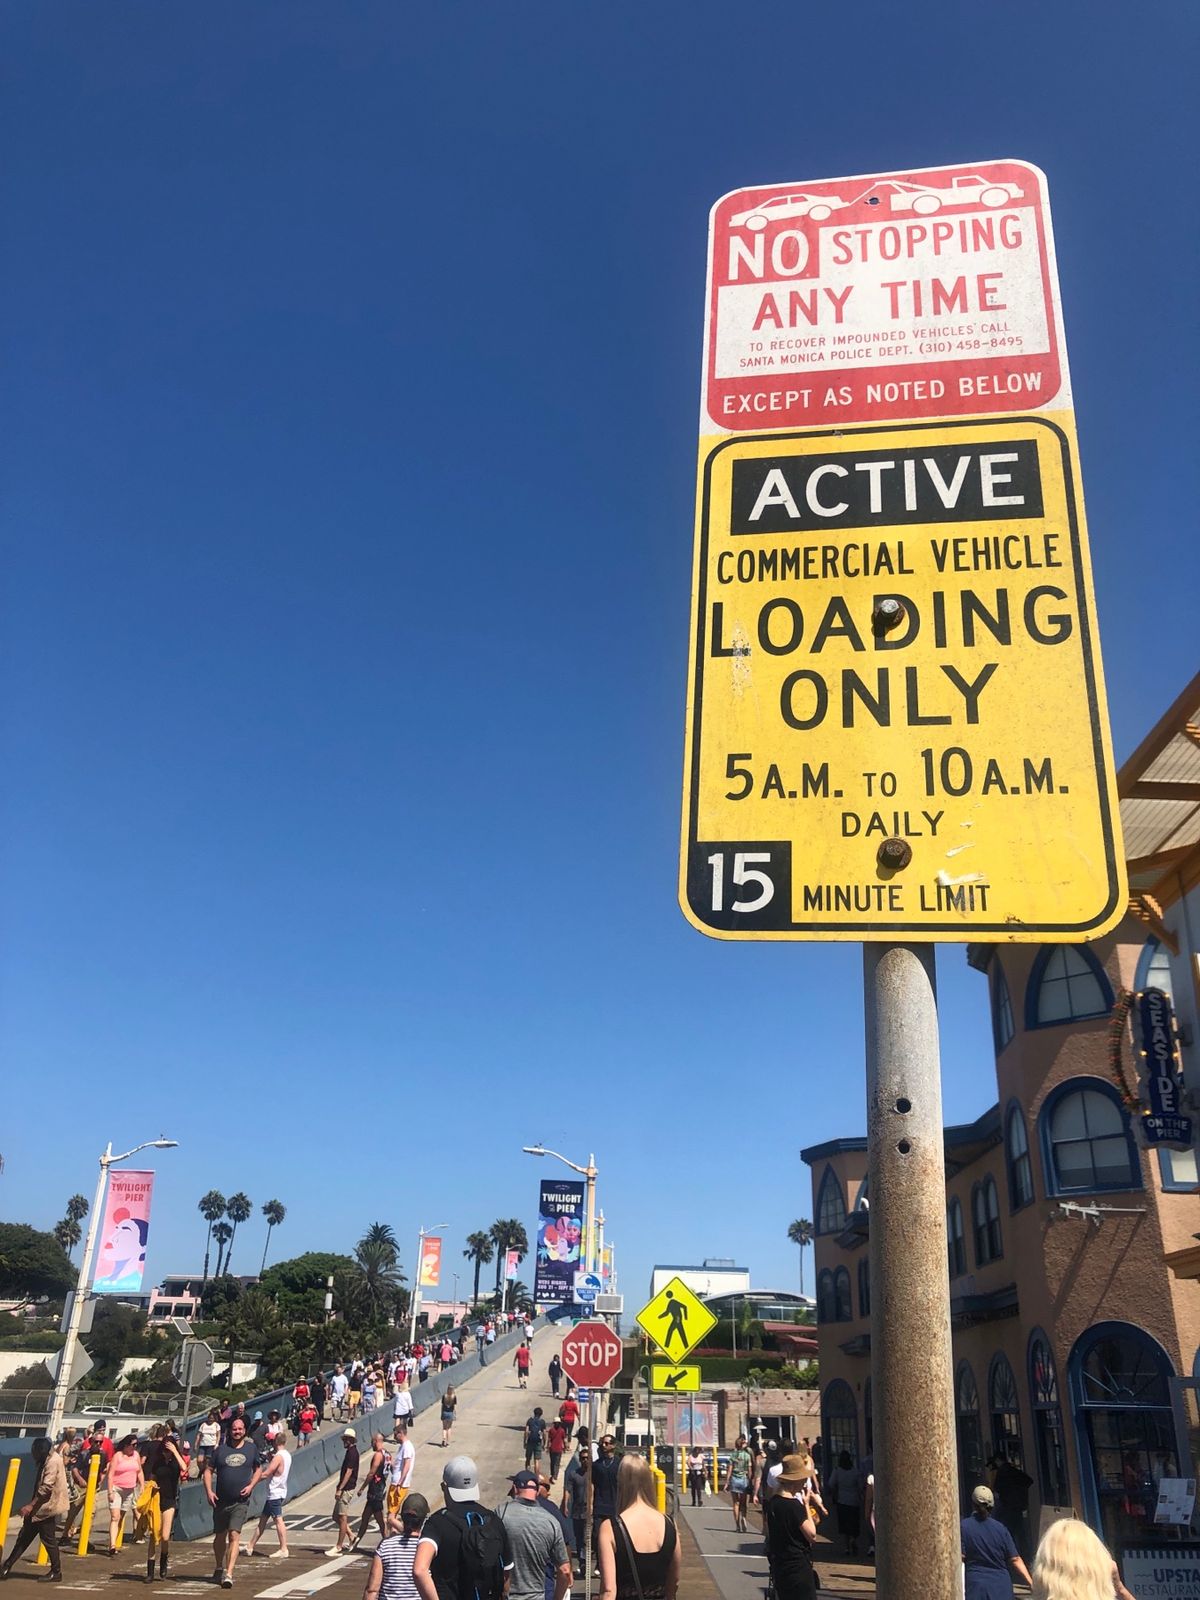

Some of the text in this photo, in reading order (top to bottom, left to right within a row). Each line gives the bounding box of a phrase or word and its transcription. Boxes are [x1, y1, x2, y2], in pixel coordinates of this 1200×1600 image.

[728, 214, 1022, 281] NO STOPPING
[752, 272, 1007, 331] ANY TIME
[750, 321, 1011, 352] TO RECOVER IMPOUNDED VEHICLES CALL
[739, 354, 775, 368] SANTA
[780, 352, 825, 365] MONICA
[830, 348, 872, 362] POLICE
[879, 344, 913, 357] DEPT.
[723, 371, 1042, 414] EXCEPT AS NOTED BELOW
[748, 452, 1025, 521] ACTIVE
[717, 533, 1062, 585] COMMERCIAL VEHICLE
[710, 585, 1073, 658] LOADING
[779, 663, 1000, 731] ONLY
[862, 772, 897, 797] TO
[841, 810, 945, 837] DAILY
[707, 852, 991, 913] 15 MINUTE LIMIT
[1148, 993, 1175, 1112] SEASIDE
[1147, 1118, 1188, 1130] ON THE
[1156, 1128, 1182, 1138] PIER
[112, 1183, 151, 1192] TWILIGHT
[542, 1193, 581, 1203] TWILIGHT
[556, 1204, 575, 1213] PIER
[565, 1342, 618, 1366] STOP
